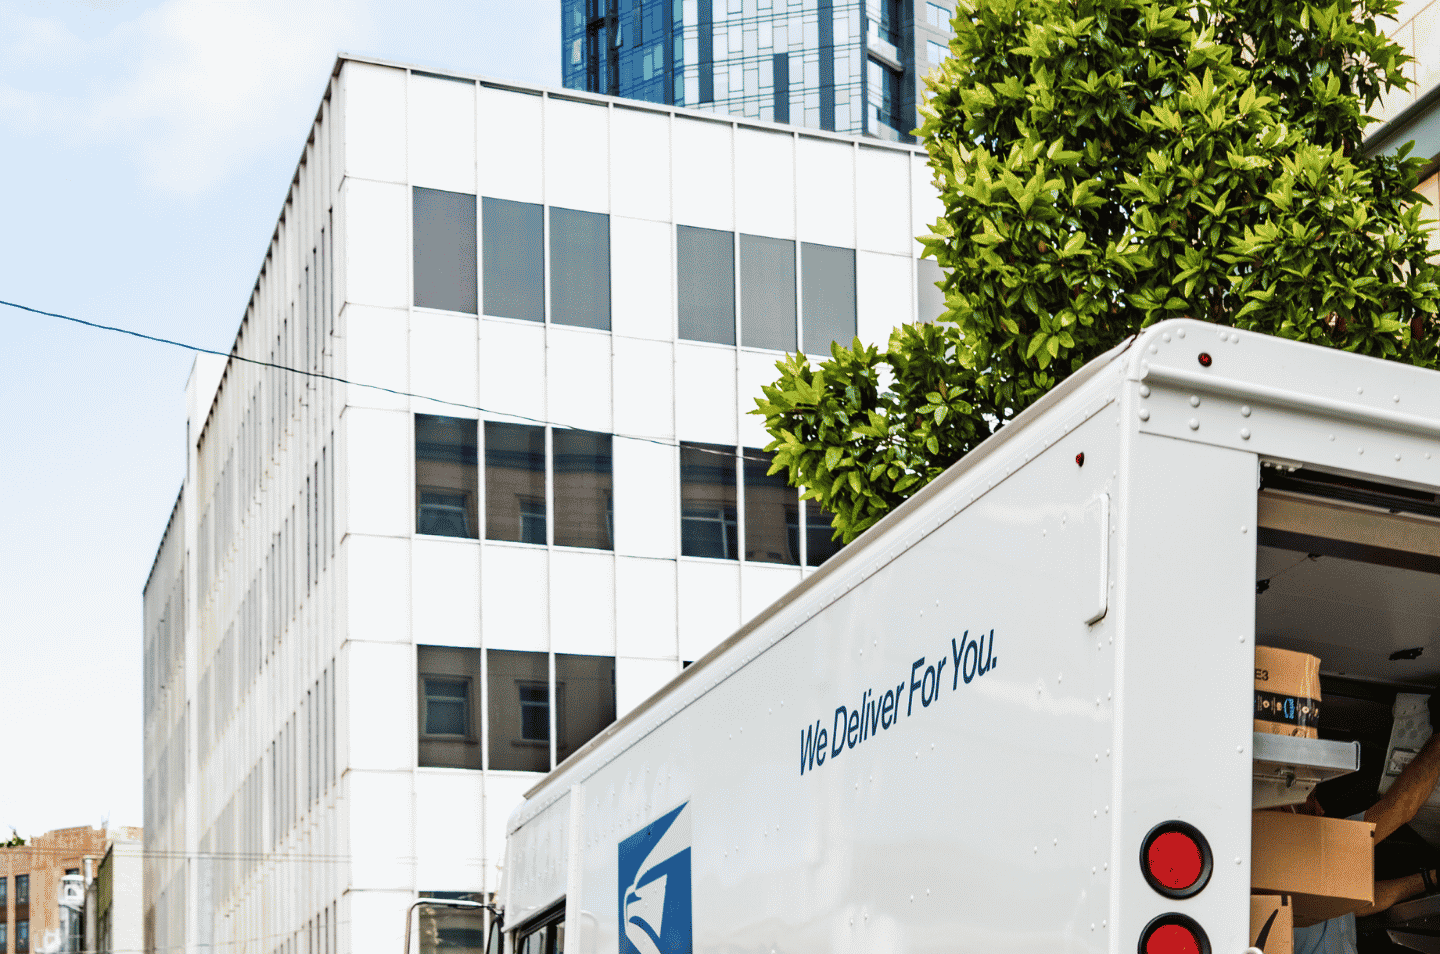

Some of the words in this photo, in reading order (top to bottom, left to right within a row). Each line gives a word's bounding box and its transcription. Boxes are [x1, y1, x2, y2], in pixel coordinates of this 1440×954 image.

[799, 718, 828, 776] We
[830, 681, 905, 760] Deliver
[906, 655, 948, 718] For
[950, 628, 998, 692] You.
